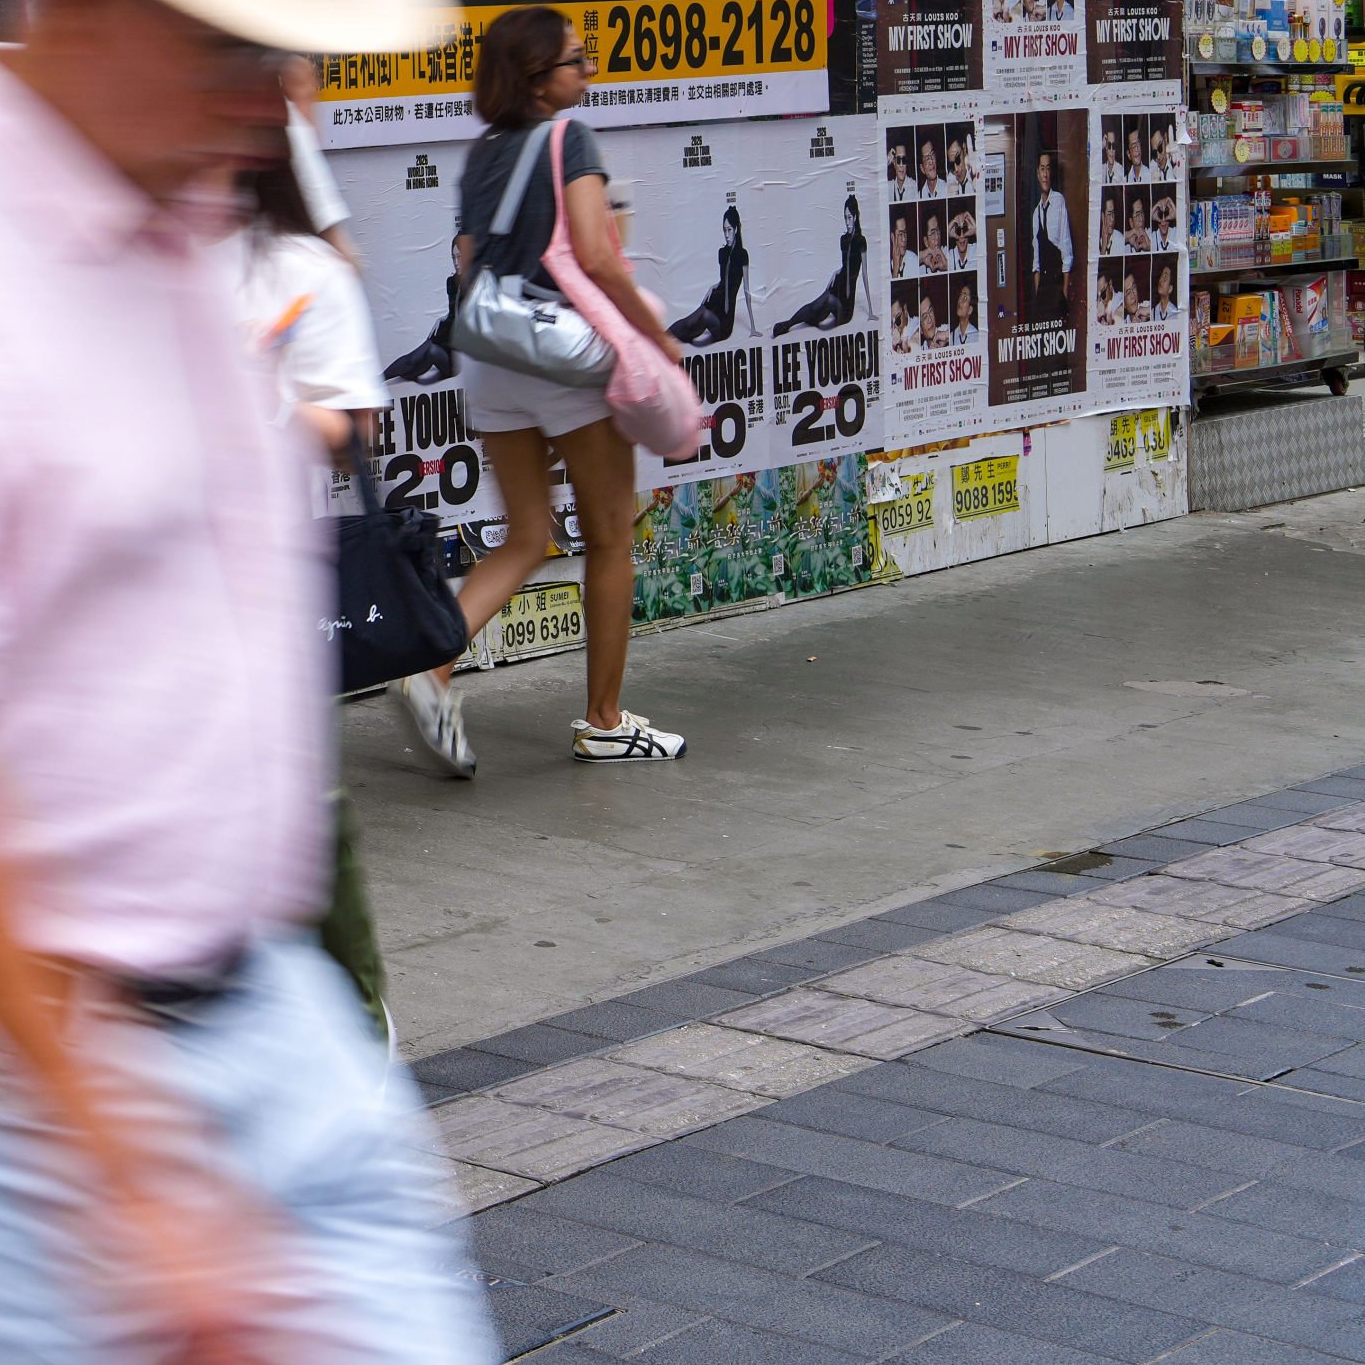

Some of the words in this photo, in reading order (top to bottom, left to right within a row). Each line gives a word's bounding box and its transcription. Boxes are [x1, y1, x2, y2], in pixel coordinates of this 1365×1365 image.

[888, 25, 907, 52] MY
[908, 24, 936, 51] FIRST
[937, 23, 972, 50] SHOW
[1004, 34, 1020, 58] MY
[1023, 34, 1043, 58] FIRST
[1045, 33, 1078, 57] SHOW
[684, 146, 698, 157] WORLD
[699, 145, 710, 155] TOUR
[1107, 335, 1125, 360] MY
[1127, 333, 1148, 358] FIRST
[1150, 332, 1180, 356] SHOW
[772, 342, 801, 395] LEE
[804, 329, 879, 389] YOUNGJI
[904, 366, 919, 390] MY
[922, 360, 947, 388] FIRST
[948, 356, 982, 385] SHOW
[792, 383, 866, 446] 2.0
[384, 444, 480, 511] 2.0
[955, 486, 988, 514] 9088
[882, 501, 913, 531] 6059
[550, 593, 569, 603] SUMEI
